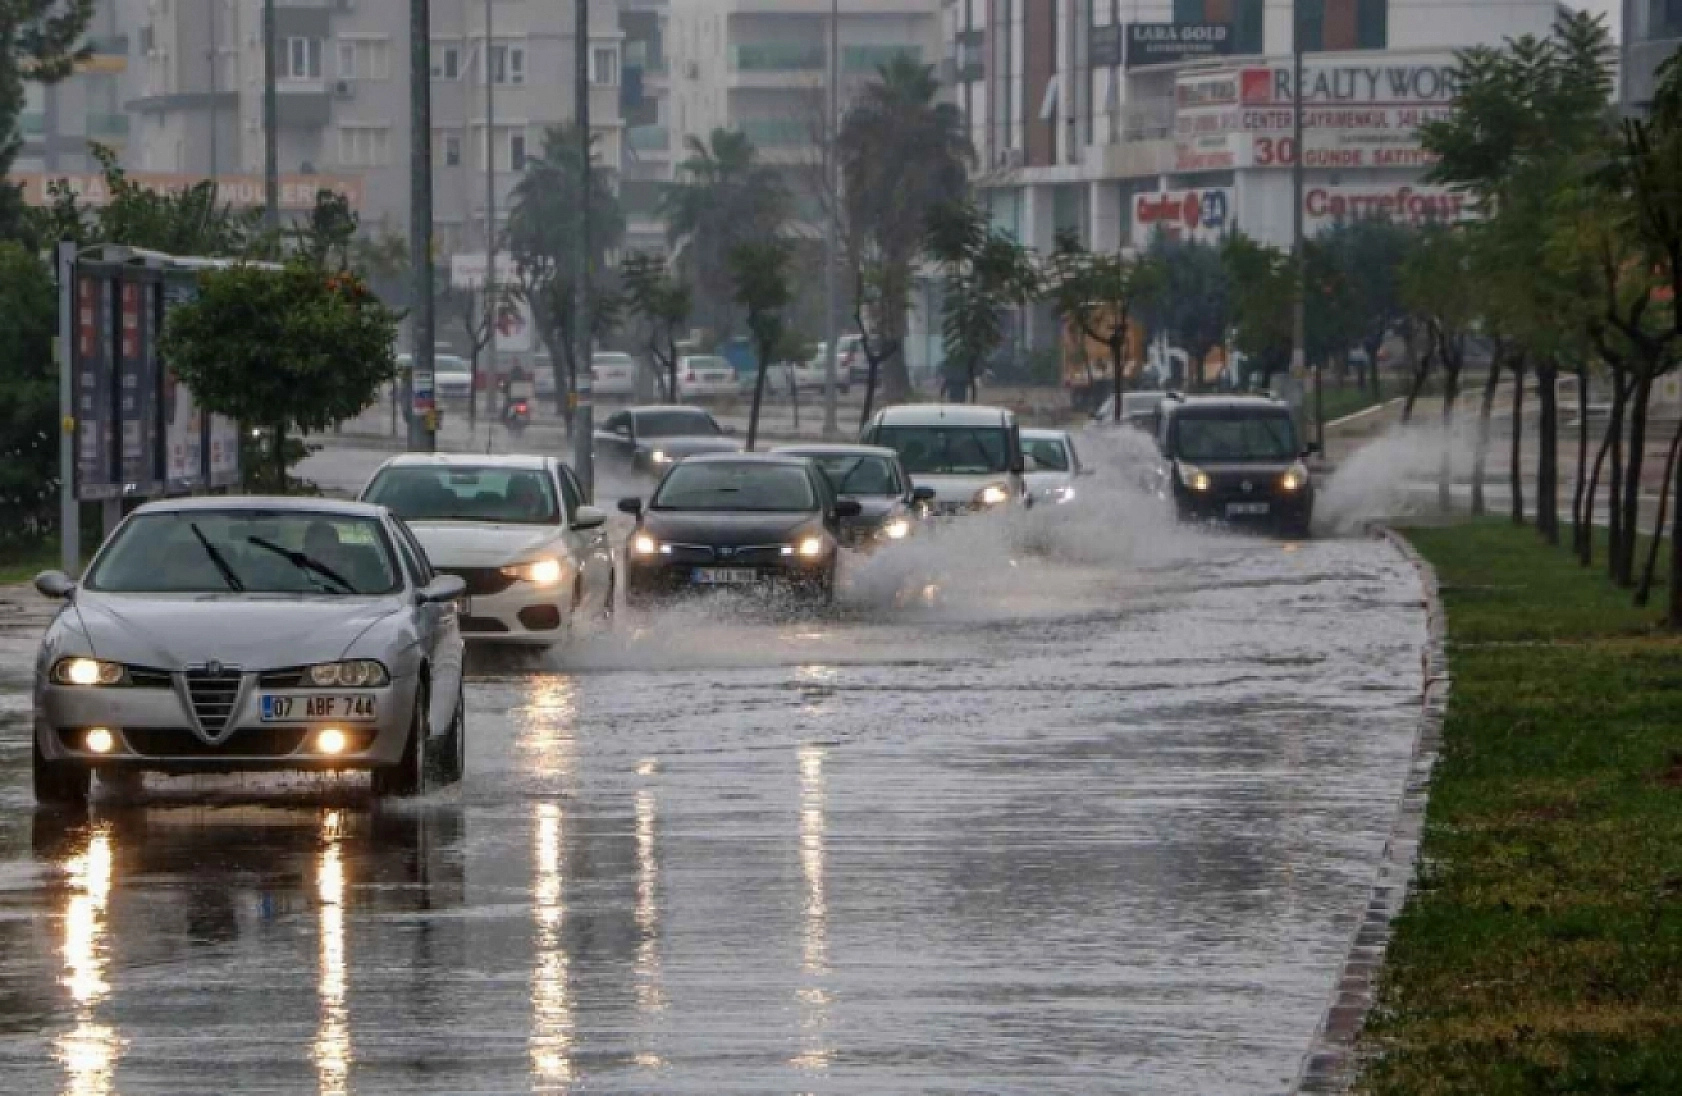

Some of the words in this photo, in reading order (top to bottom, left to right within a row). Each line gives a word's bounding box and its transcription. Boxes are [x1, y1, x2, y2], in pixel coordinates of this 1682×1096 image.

[1275, 68, 1381, 100] REALTY
[1243, 110, 1292, 129] CENTER
[1254, 137, 1295, 166] 30
[274, 697, 293, 716] 07
[306, 697, 335, 716] ABF
[343, 697, 373, 716] 744
